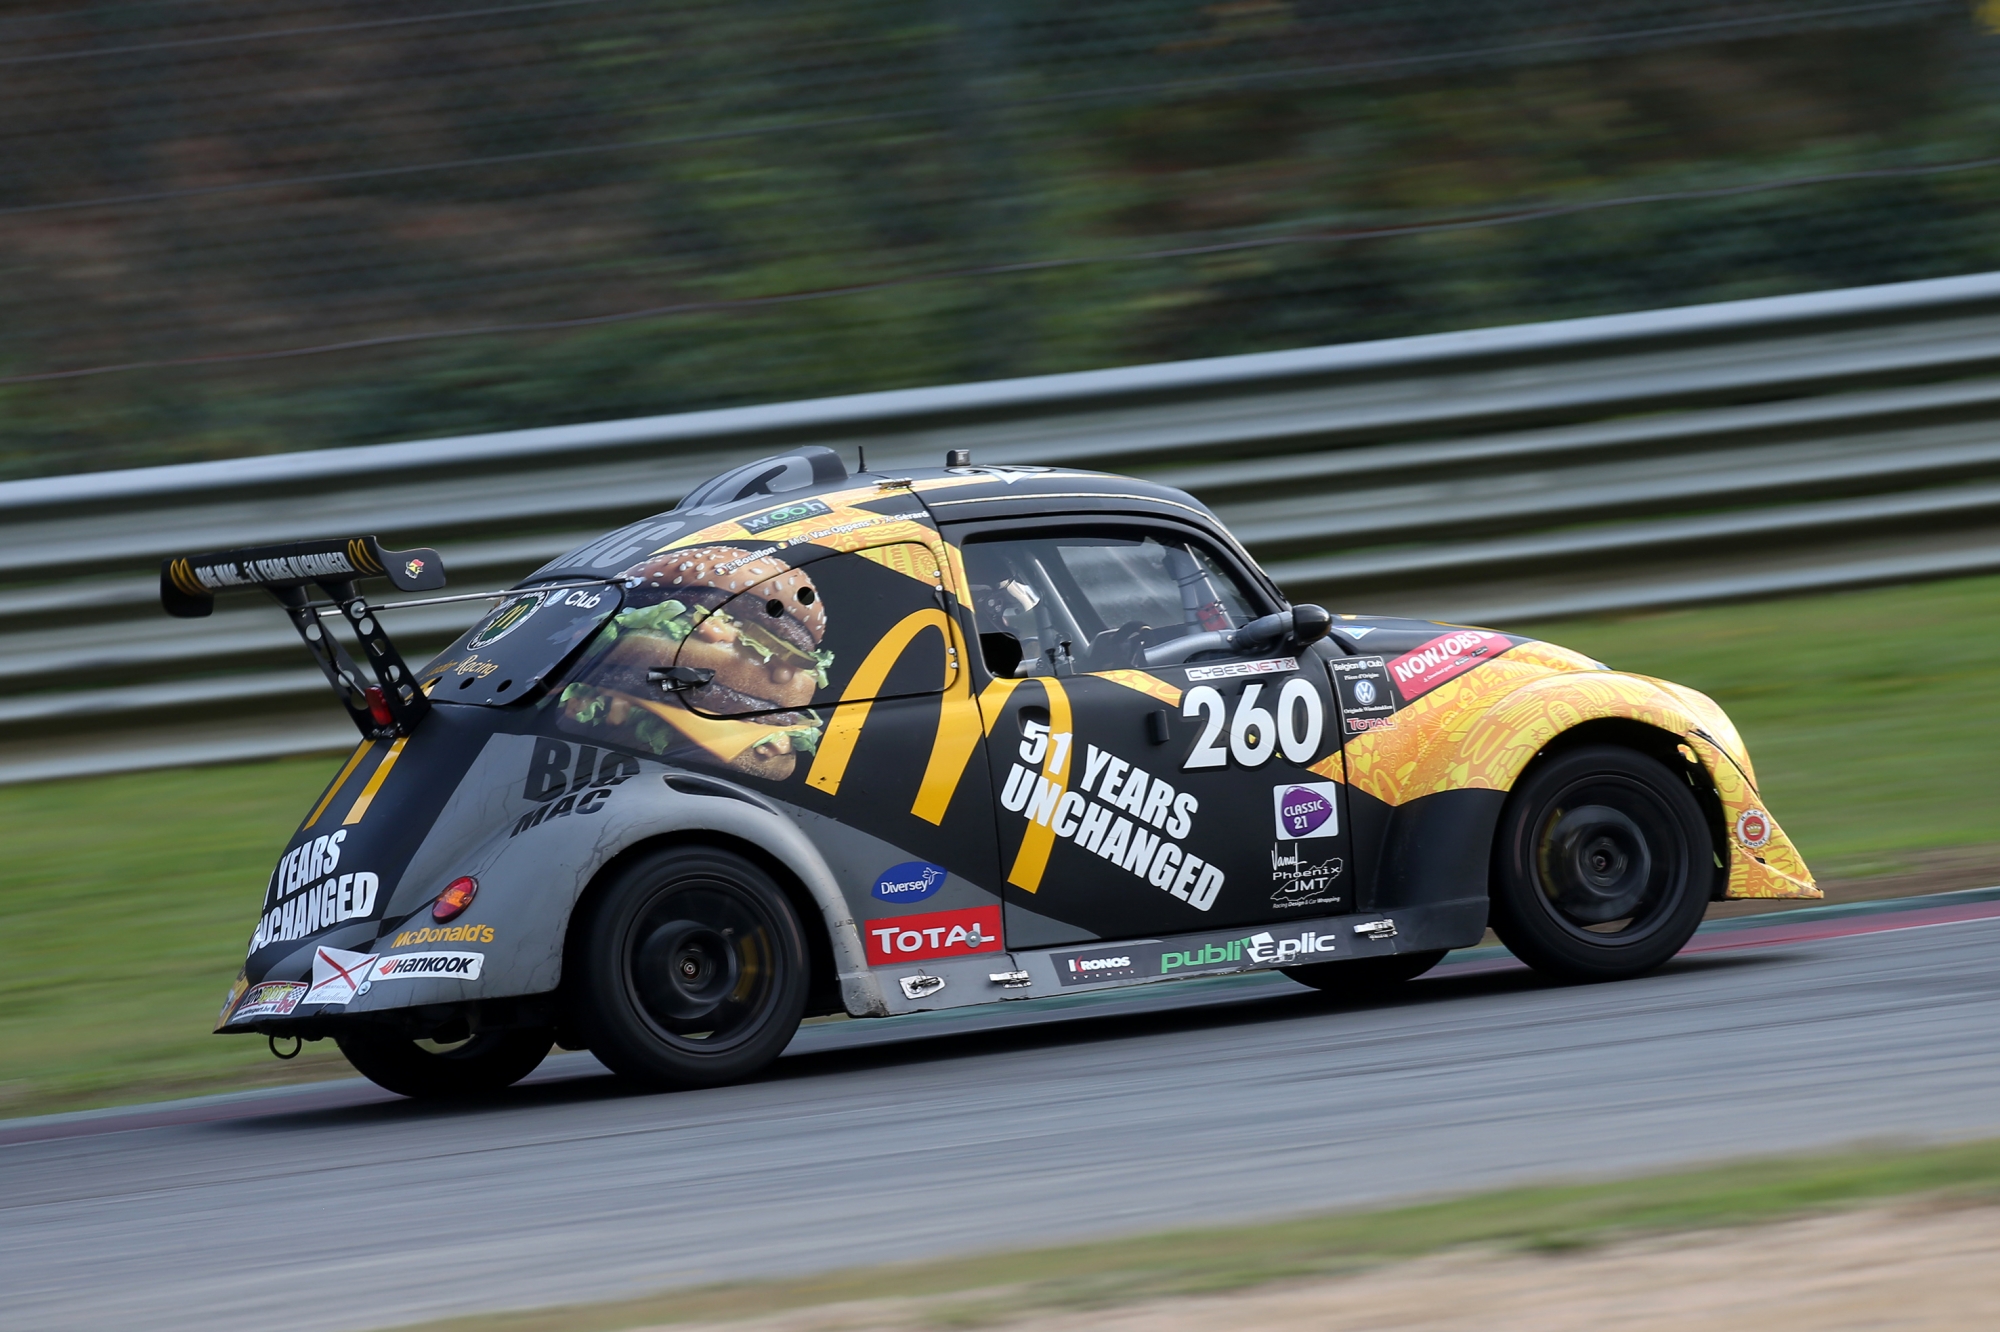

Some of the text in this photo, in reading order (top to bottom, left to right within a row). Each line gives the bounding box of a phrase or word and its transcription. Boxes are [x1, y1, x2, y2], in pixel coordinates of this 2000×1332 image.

[735, 546, 777, 567] Bouillon
[810, 528, 832, 540] Van
[831, 520, 871, 534] Oppens
[255, 556, 297, 581] YEARS
[287, 551, 355, 578] UNCHANGED
[564, 590, 602, 609] Club
[453, 654, 499, 679] Racing
[1334, 663, 1359, 671] Belgian
[1394, 631, 1482, 682] NOWJOBS
[1182, 677, 1324, 769] 260
[522, 736, 640, 803] BIG
[1018, 719, 1199, 840] 51 YEARS
[509, 788, 613, 839] MAC
[1283, 799, 1325, 817] CLASSIC
[1293, 815, 1309, 830] 21
[1000, 762, 1226, 912] UNCHANGED
[276, 828, 348, 901] YEARS
[1272, 866, 1340, 881] Phoenix
[880, 880, 929, 895] Diversey
[1284, 877, 1329, 893] JMT
[390, 923, 495, 949] McDonald's
[871, 922, 996, 955] TOTAL
[1067, 955, 1132, 973] KRONOS
[1160, 940, 1242, 974] publi
